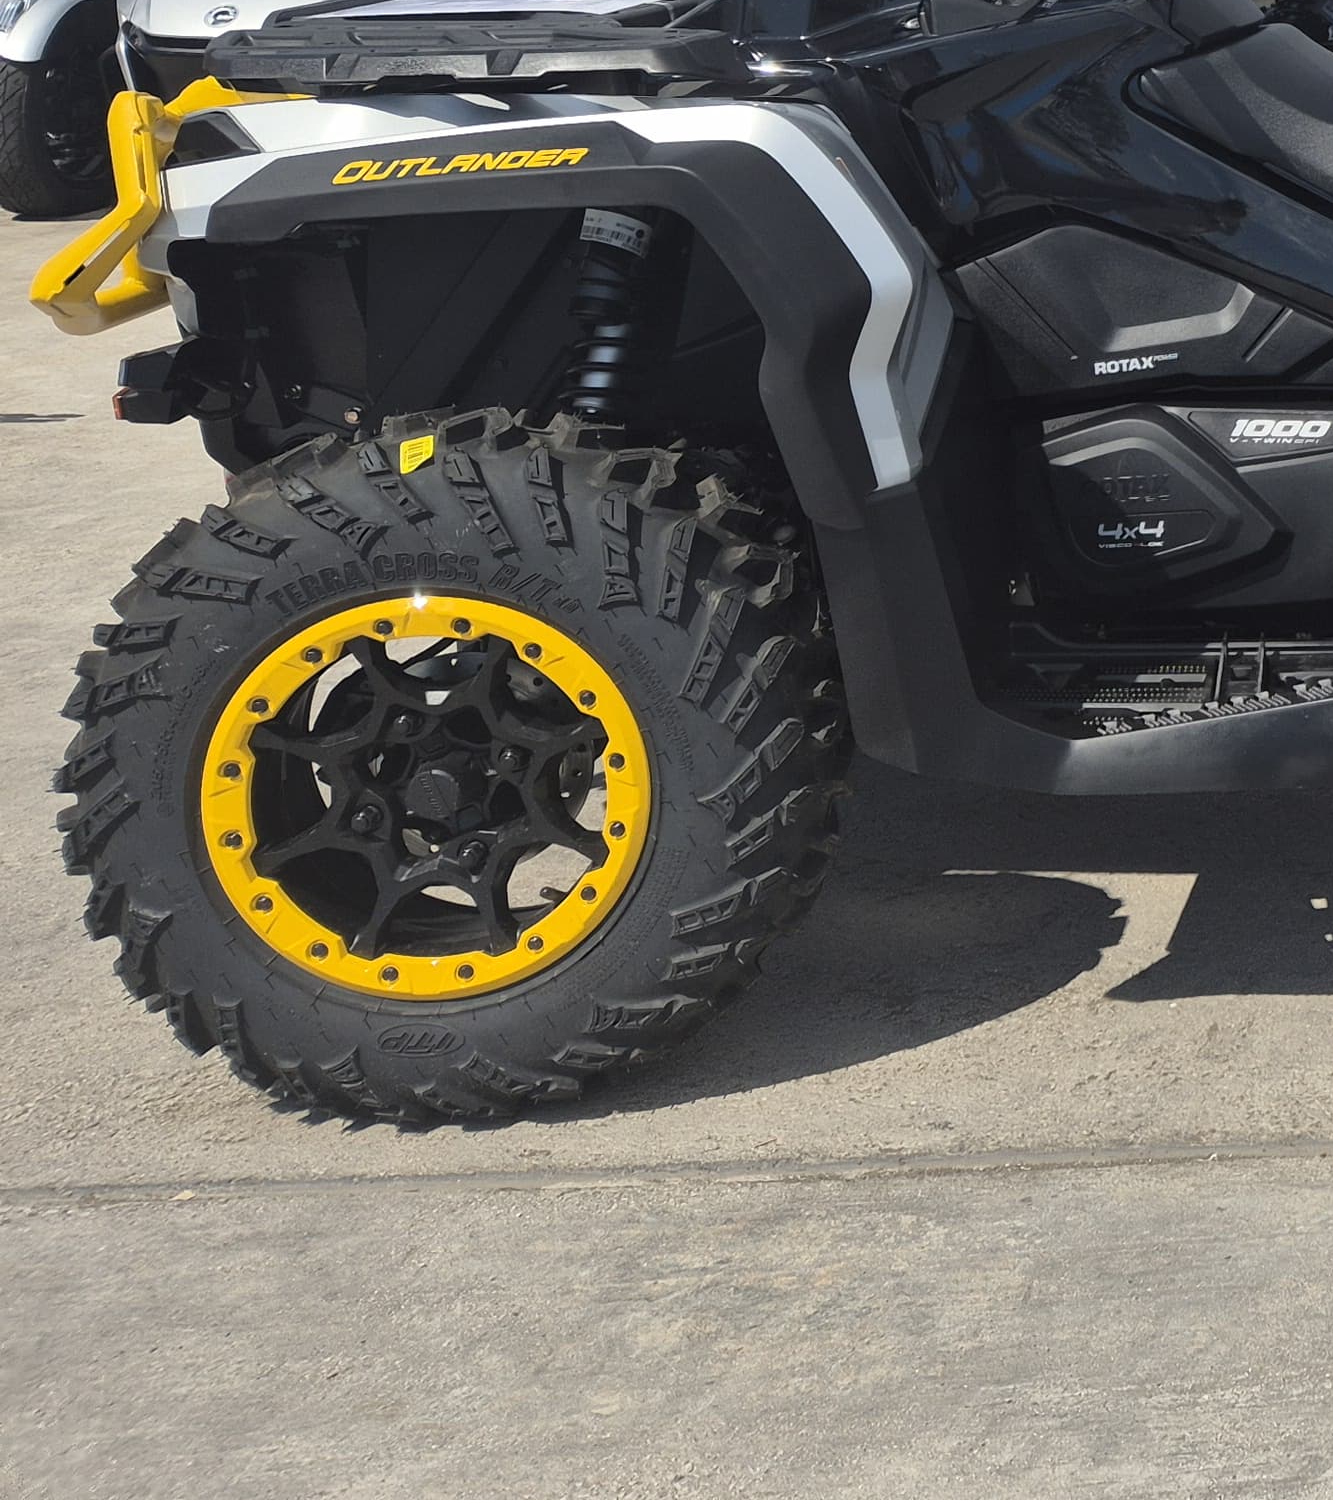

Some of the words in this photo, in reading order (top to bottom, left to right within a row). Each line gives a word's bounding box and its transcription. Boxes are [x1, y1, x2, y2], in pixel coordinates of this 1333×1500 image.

[331, 146, 590, 186] OUTLANDER
[1094, 355, 1154, 376] ROTAX
[1230, 419, 1332, 438] 1000
[264, 558, 367, 617] TERRA
[372, 551, 480, 584] CROSS
